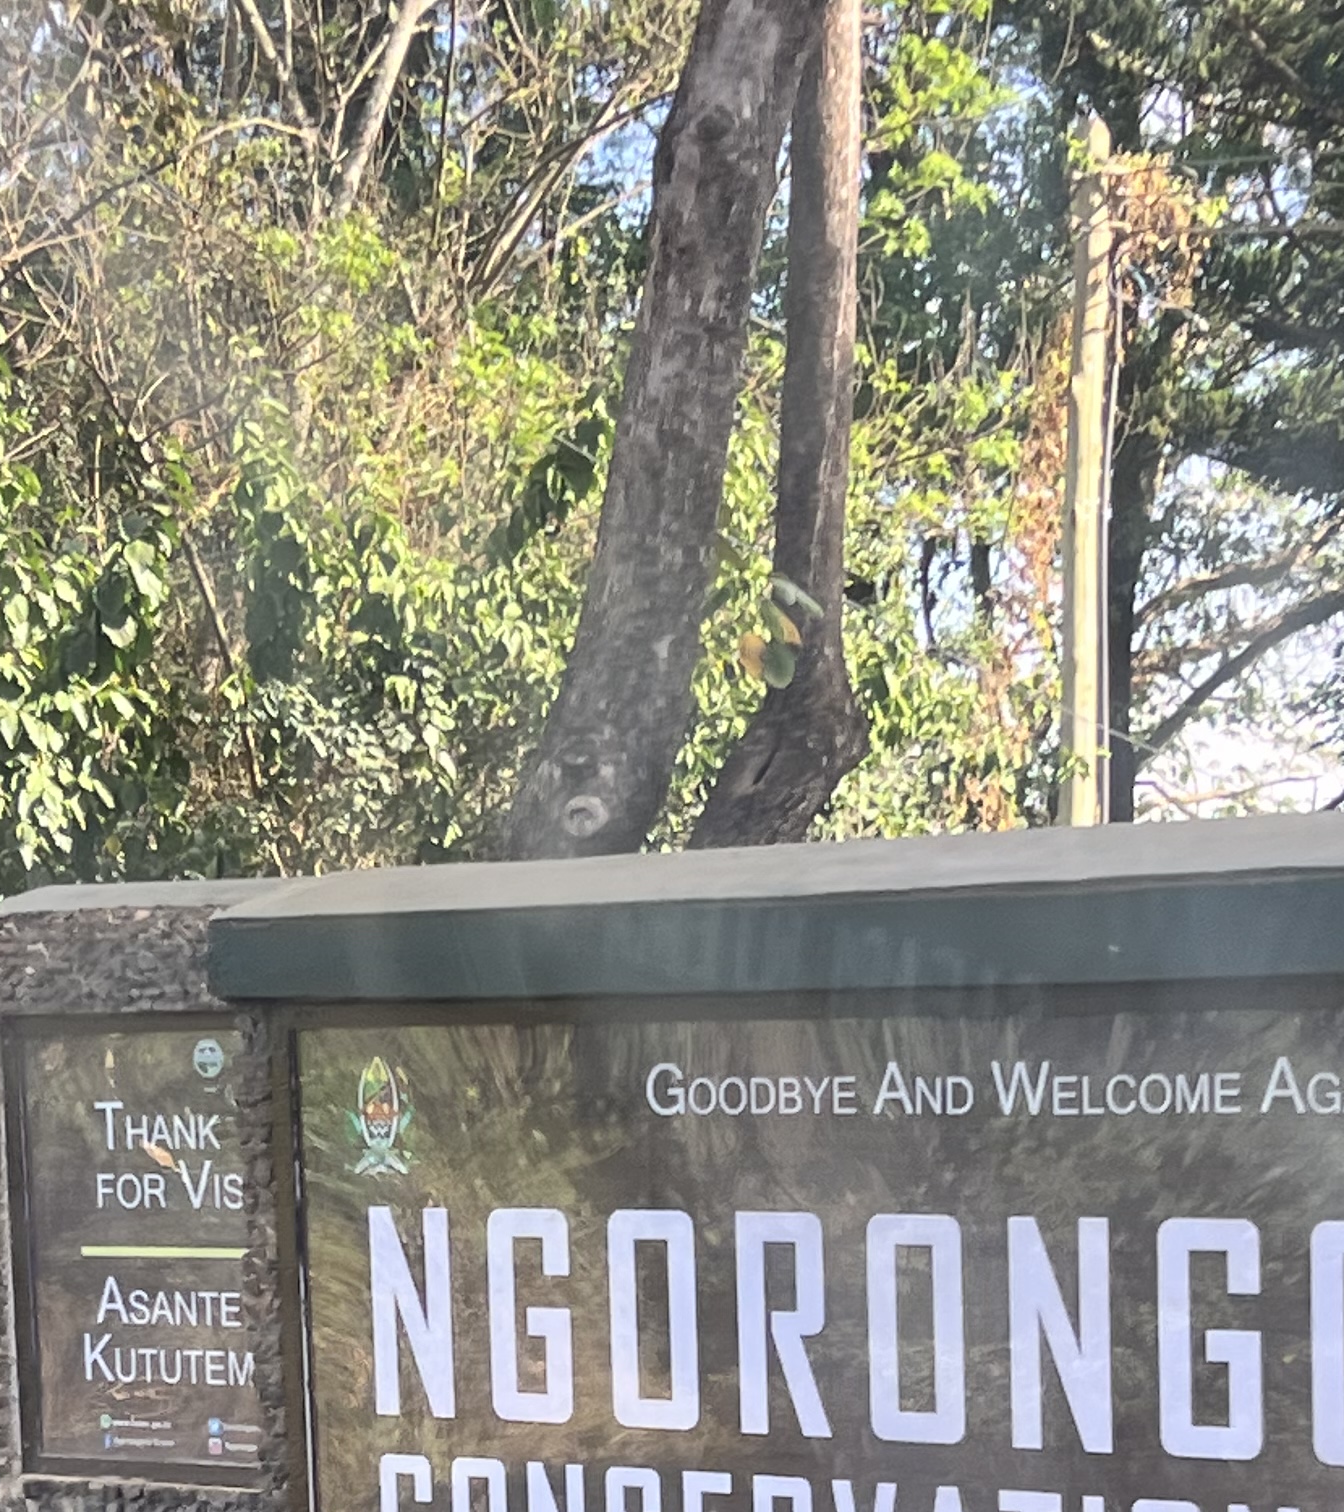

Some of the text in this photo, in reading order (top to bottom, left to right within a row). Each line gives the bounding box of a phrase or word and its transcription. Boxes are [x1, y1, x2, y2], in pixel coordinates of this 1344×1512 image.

[646, 1062, 858, 1116] GOODBYE
[873, 1061, 974, 1115] AND
[990, 1060, 1242, 1116] WELCOME
[93, 1100, 222, 1151] THANK
[96, 1173, 167, 1209] FOR
[96, 1275, 243, 1328] ASANTE
